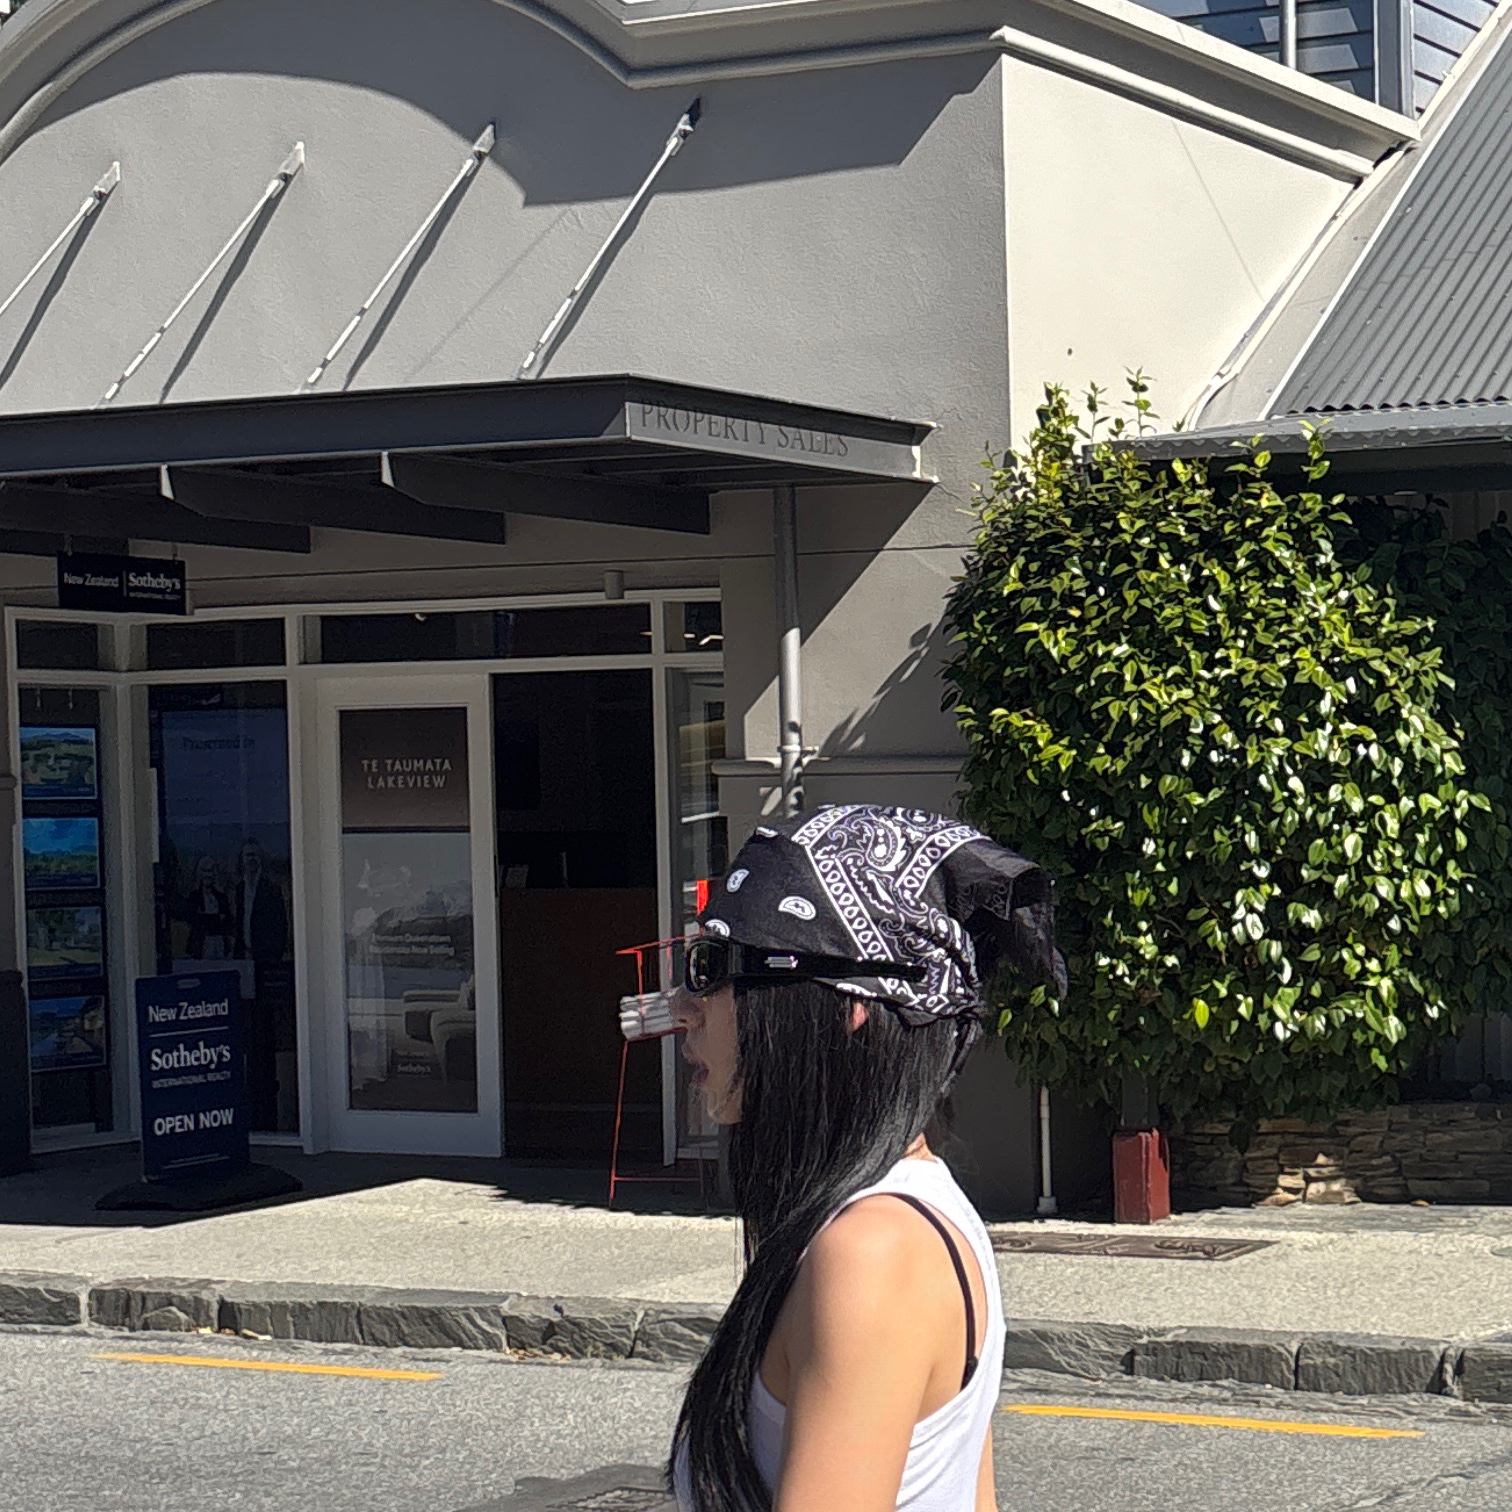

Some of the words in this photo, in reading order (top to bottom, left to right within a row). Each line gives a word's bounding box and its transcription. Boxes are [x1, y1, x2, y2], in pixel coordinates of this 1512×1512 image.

[640, 401, 766, 445] PROPERTY
[776, 418, 849, 458] SALES
[63, 571, 84, 585] New
[84, 573, 119, 588] Zealand
[128, 571, 181, 592] Sotheby's
[361, 758, 379, 773] TE
[385, 757, 452, 773] TAUMATA
[367, 774, 446, 789] LAKEVIEW
[147, 1005, 177, 1023] New
[177, 998, 229, 1021] Zealand
[150, 1039, 231, 1072] Sotheby's
[153, 1113, 195, 1137] OPEN
[198, 1107, 235, 1130] NOW
